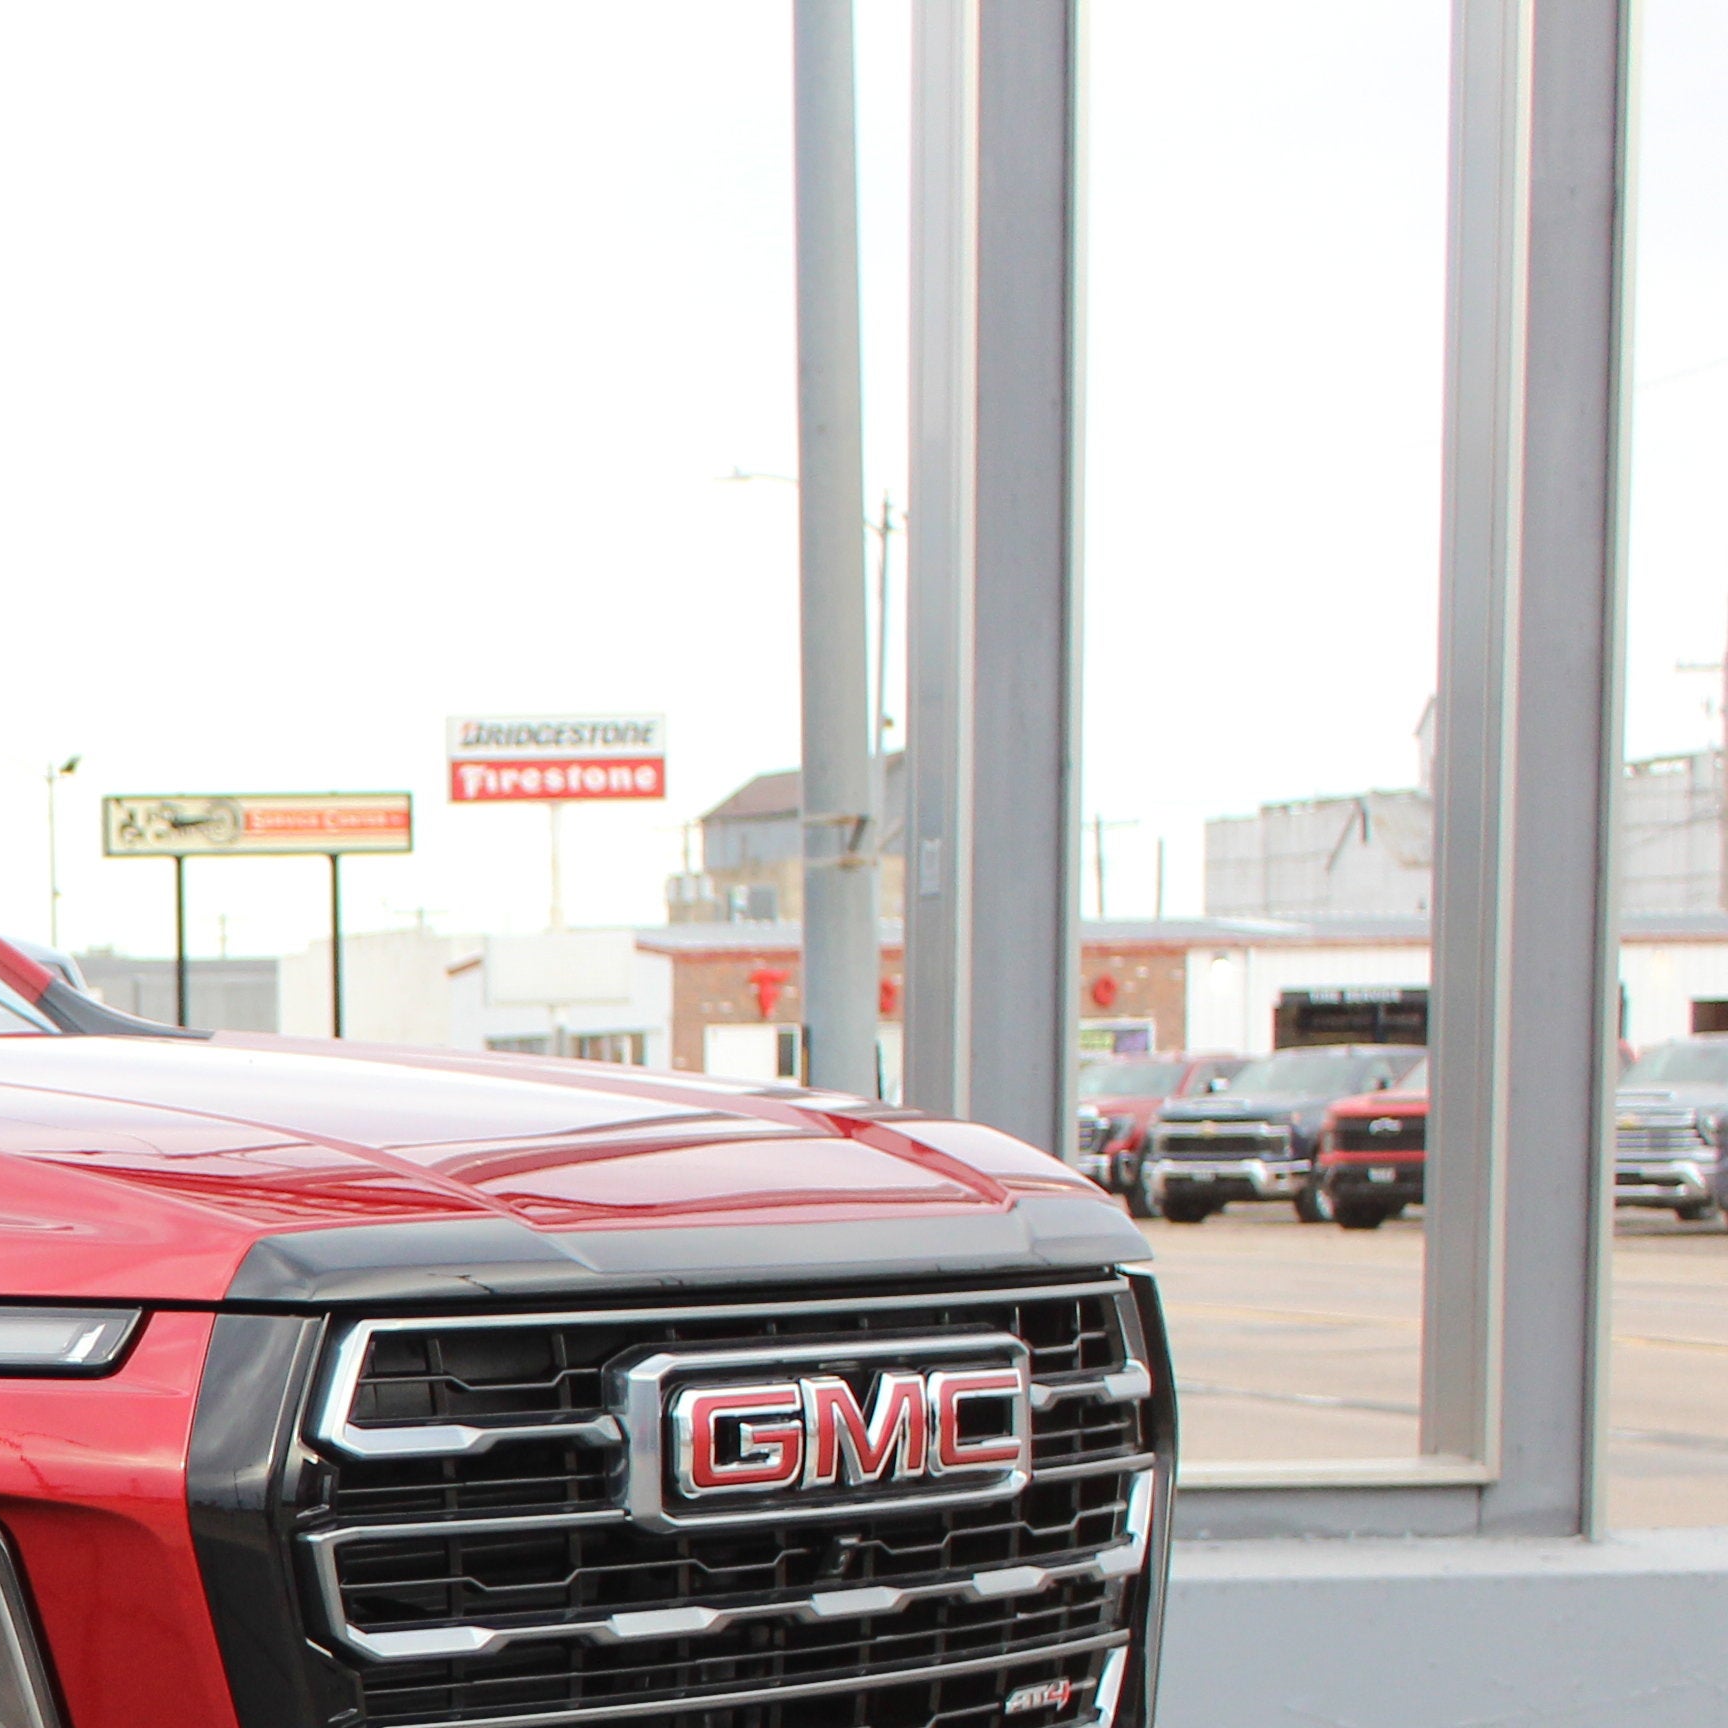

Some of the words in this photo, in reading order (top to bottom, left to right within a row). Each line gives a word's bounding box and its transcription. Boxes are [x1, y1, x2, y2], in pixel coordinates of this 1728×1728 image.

[462, 720, 656, 746] BRIDGESTONE
[460, 764, 657, 799] Firestone
[676, 1368, 1022, 1499] GMC
[1005, 1678, 1070, 1714] AT4
